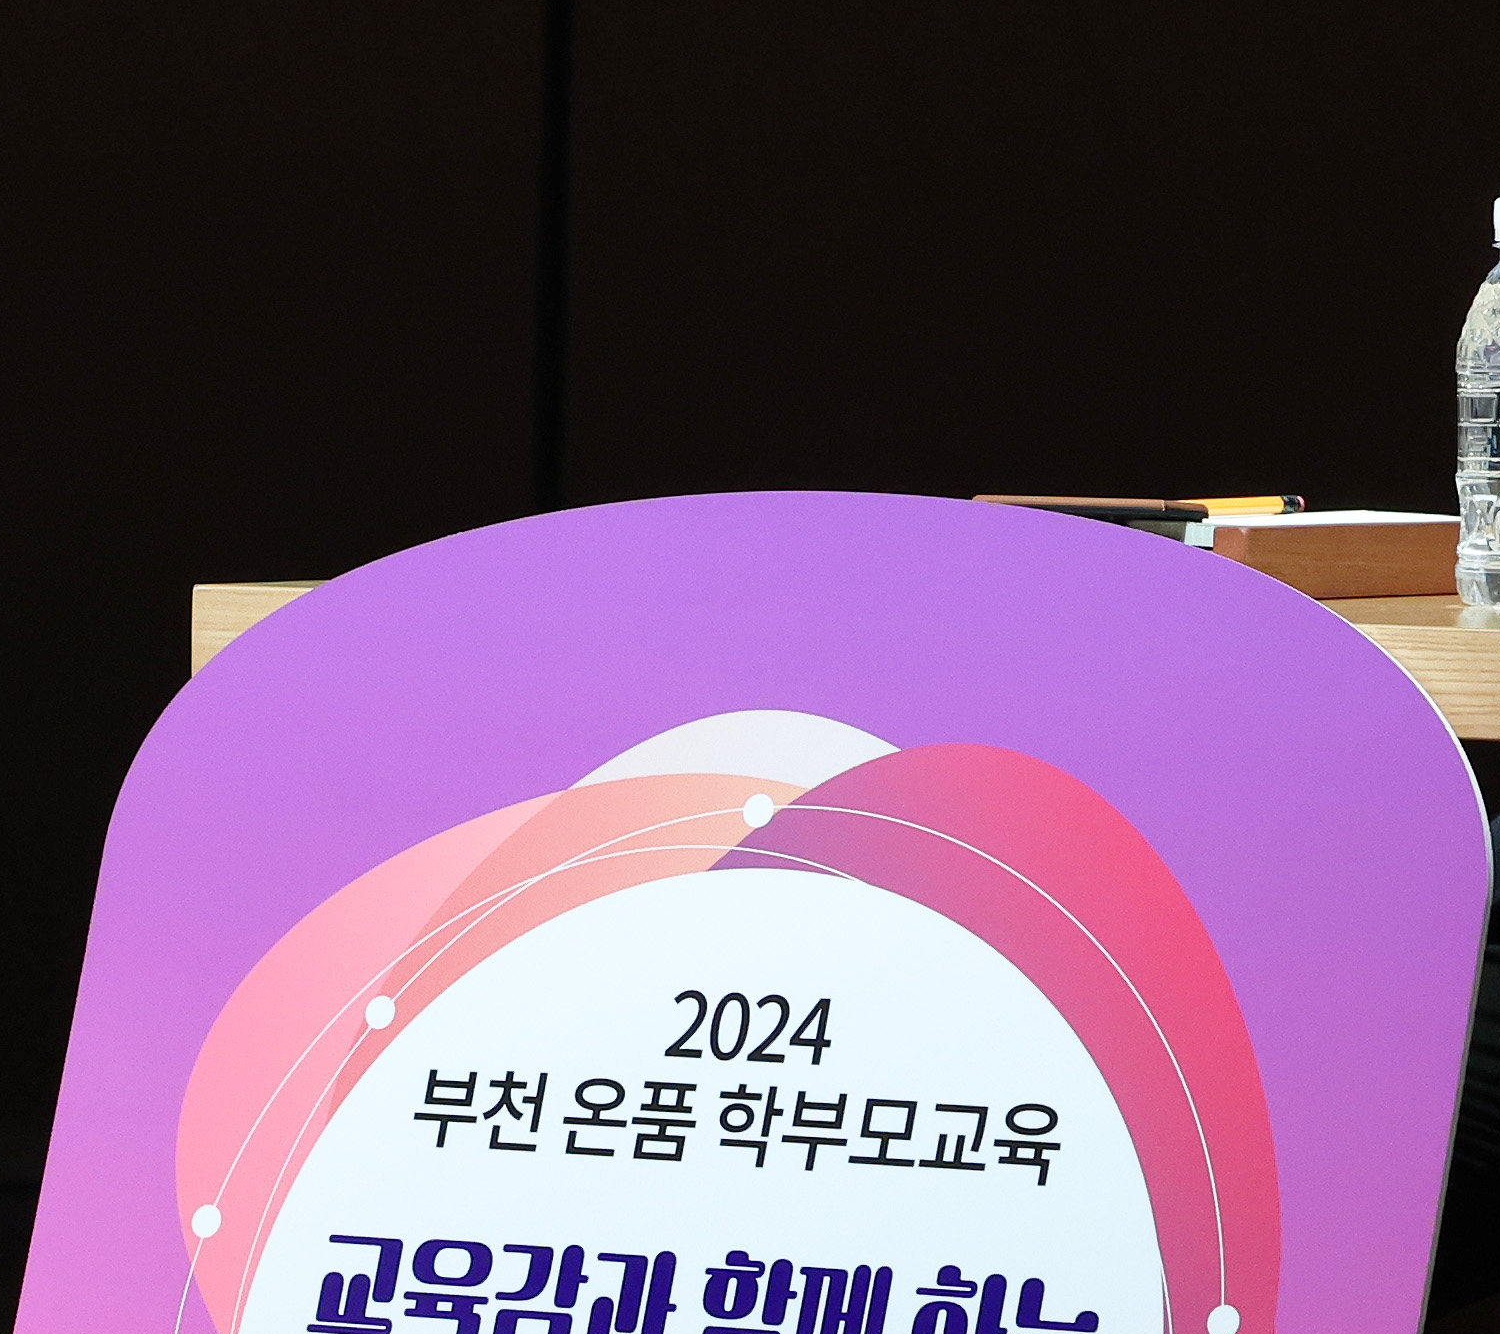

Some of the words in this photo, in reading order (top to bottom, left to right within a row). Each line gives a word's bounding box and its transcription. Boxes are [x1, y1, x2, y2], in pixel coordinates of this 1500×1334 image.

[665, 990, 831, 1065] 2024
[414, 1069, 548, 1151] 부천
[563, 1079, 697, 1161] 온품
[720, 1084, 1060, 1186] 학부모교육
